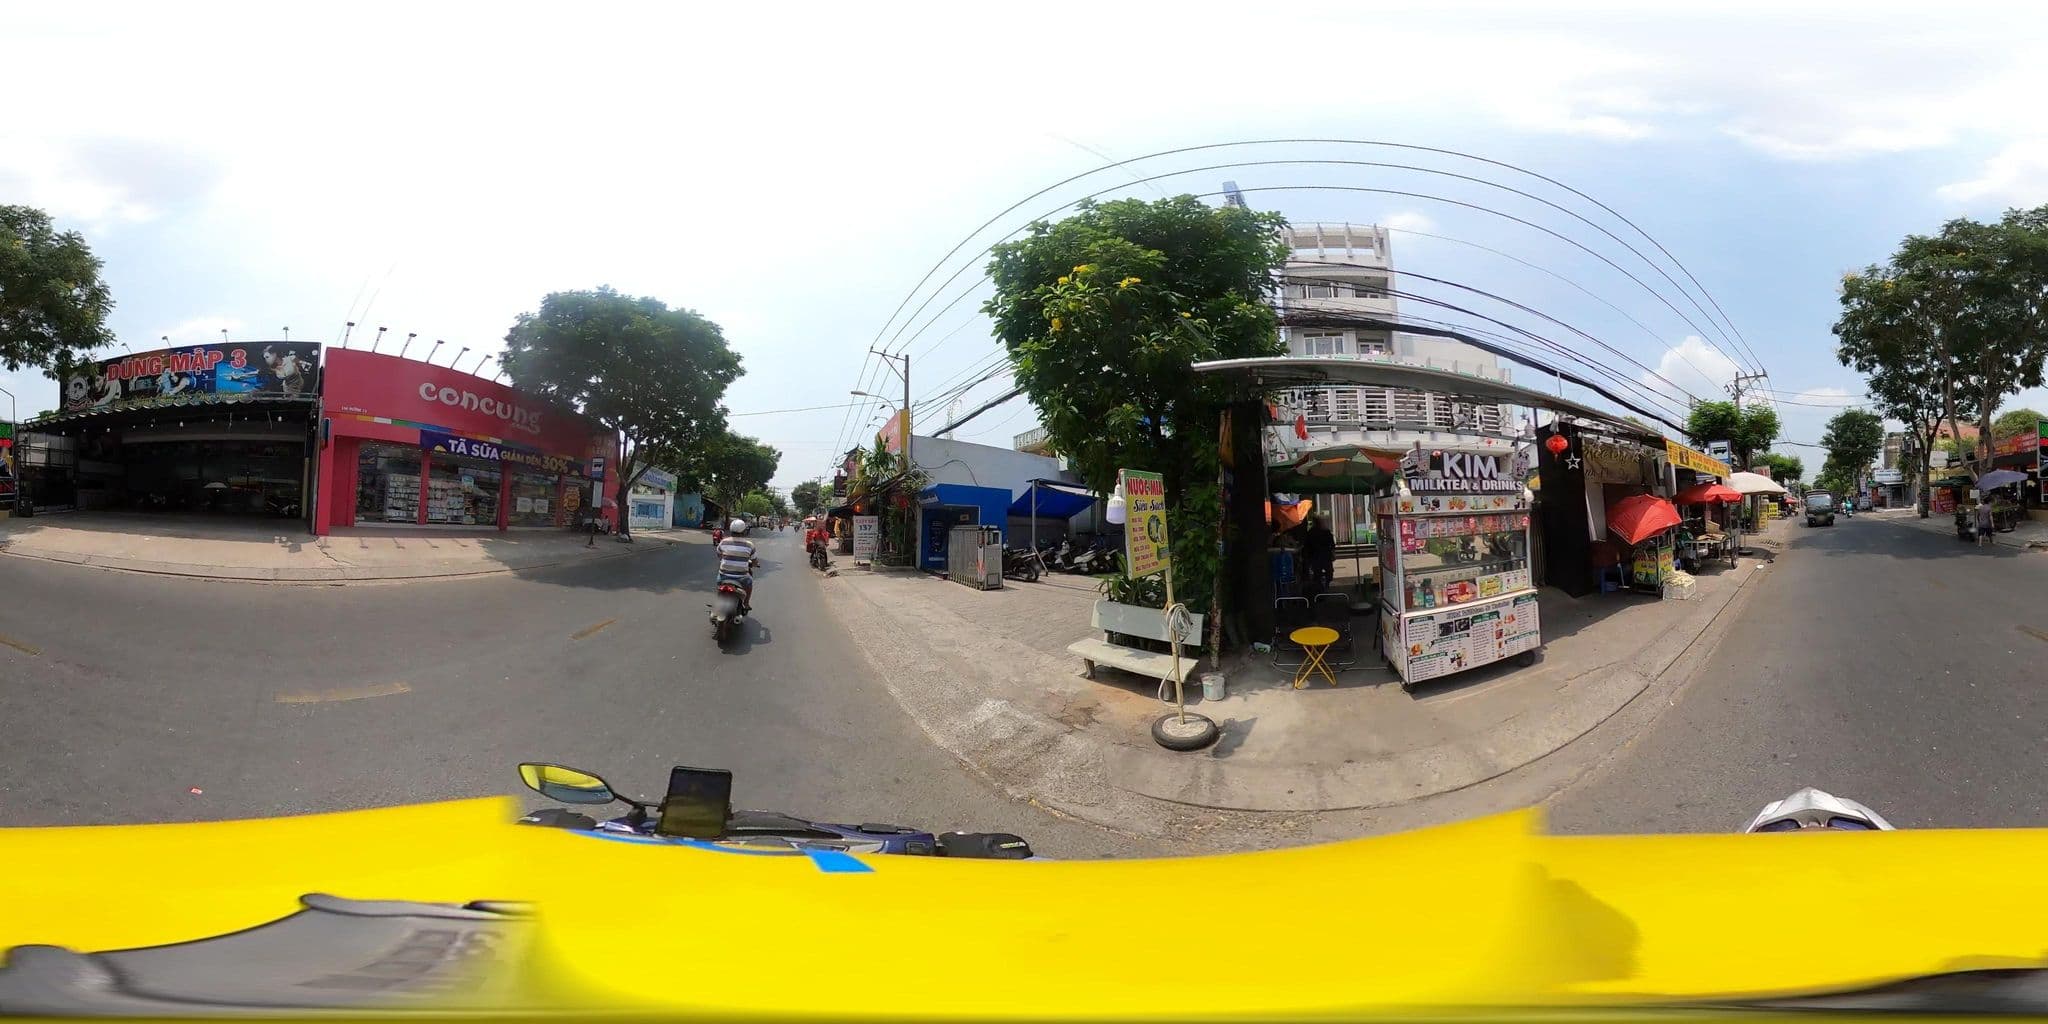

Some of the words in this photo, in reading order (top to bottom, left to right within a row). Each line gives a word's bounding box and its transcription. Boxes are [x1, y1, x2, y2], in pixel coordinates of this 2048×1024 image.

[170, 347, 223, 375] MẬP
[230, 348, 247, 369] 3
[448, 438, 468, 455] TÃ
[471, 442, 500, 461] SỮA
[542, 455, 569, 474] 30%
[1442, 452, 1498, 479] KIM
[1411, 479, 1469, 491] MILKTEA
[1471, 482, 1479, 491] &
[1482, 479, 1524, 491] DRINKS
